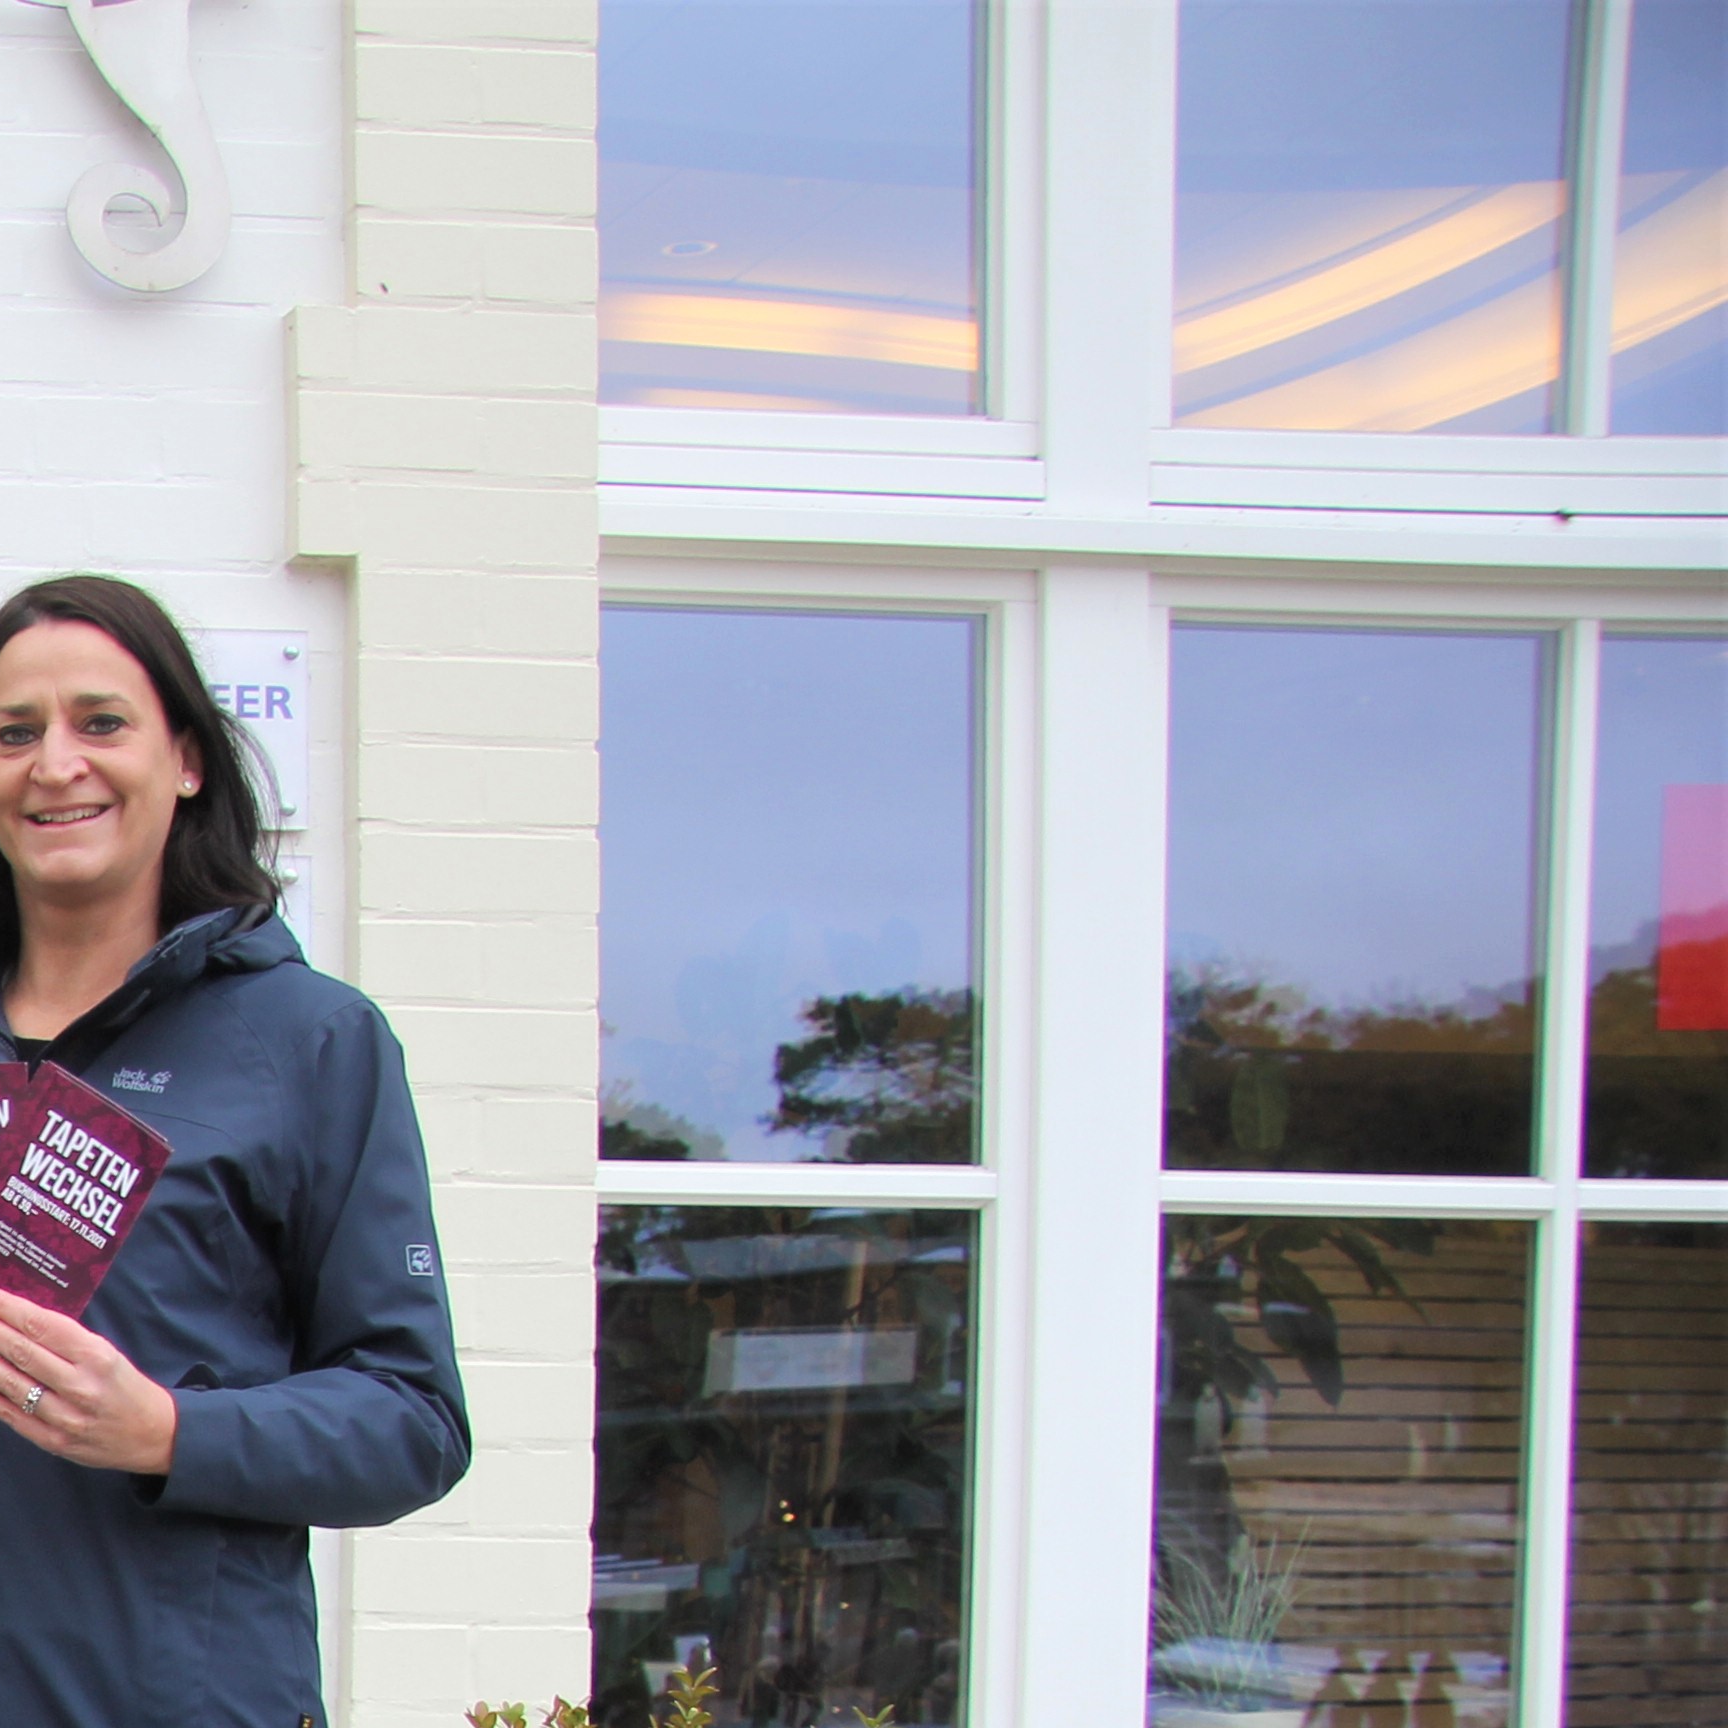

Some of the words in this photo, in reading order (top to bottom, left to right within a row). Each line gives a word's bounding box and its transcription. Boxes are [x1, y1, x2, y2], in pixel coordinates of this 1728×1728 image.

[114, 1067, 147, 1081] Jack
[112, 1075, 165, 1094] Wolfskin
[38, 1110, 140, 1198] TAPETEN
[0, 1187, 15, 1201] AB
[20, 1143, 124, 1236] WECHSEL
